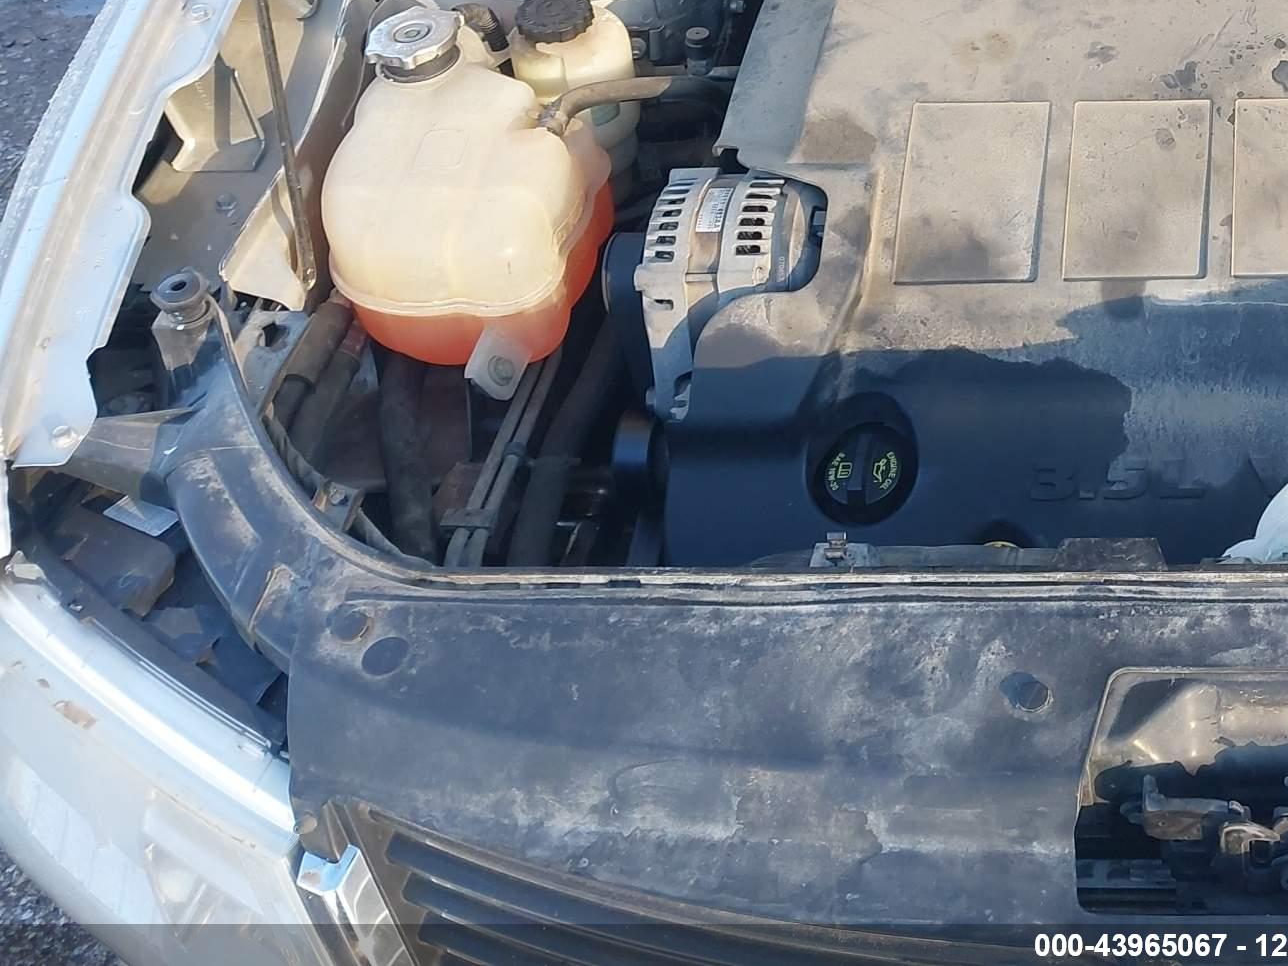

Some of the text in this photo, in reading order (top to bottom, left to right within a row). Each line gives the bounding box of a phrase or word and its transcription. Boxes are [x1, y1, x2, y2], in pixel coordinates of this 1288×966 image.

[879, 451, 897, 490] ENGINE OIL
[1031, 458, 1206, 501] 3.5L
